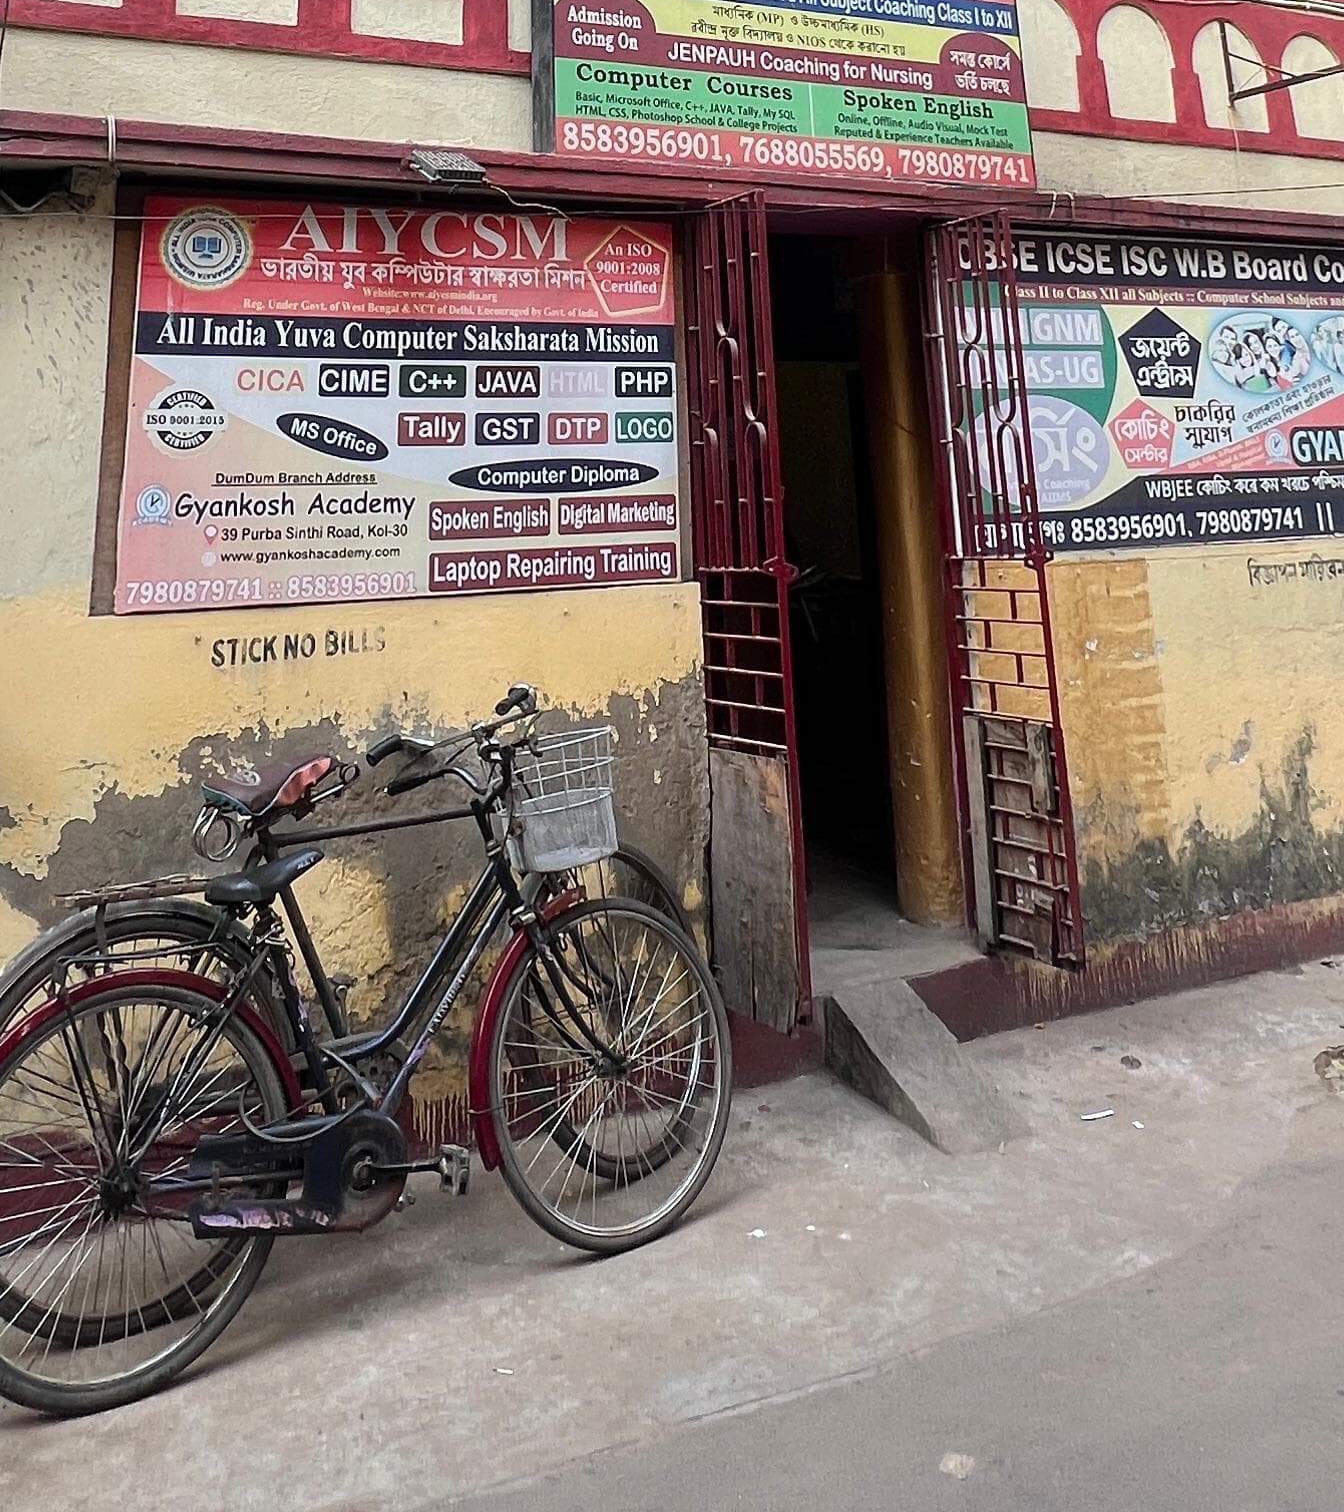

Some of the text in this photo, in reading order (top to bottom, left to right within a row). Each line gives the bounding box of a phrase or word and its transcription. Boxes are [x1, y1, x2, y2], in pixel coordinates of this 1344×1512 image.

[567, 5, 642, 30] Admission
[937, 2, 973, 24] Class
[981, 9, 995, 27] to
[571, 26, 639, 52] Going On
[668, 41, 934, 89] JENPAUH Coaching for Nursing
[576, 62, 794, 101] Computer Courses
[606, 93, 652, 108] Microsoft
[653, 97, 683, 112] Office,
[763, 108, 776, 121] My
[778, 109, 796, 121] SQL
[844, 88, 994, 120] Spoken English
[563, 121, 1029, 184] 8583956901, 7688055569, 7980879741
[278, 204, 573, 263] AIYCSM
[604, 244, 653, 259] An ISO
[1045, 240, 1115, 276] ICSE
[1120, 244, 1167, 277] ISC
[1173, 247, 1227, 280] W.B
[1233, 250, 1307, 283] Board
[260, 252, 336, 283] ভারতীয়
[341, 258, 366, 290] যুব
[371, 257, 465, 287] কম্পিউটার
[543, 263, 588, 290] মিশন
[596, 261, 660, 276] 9001:2008
[601, 279, 657, 295] Certified
[157, 317, 659, 357] All India Yuva Computer Saksharata Mission
[1032, 311, 1102, 343] GNM
[236, 369, 306, 392] CICA
[320, 369, 389, 392] CIME
[409, 370, 458, 393] C++
[478, 370, 538, 393] JAVA
[550, 371, 606, 394] HTML
[620, 370, 669, 393] PHP
[289, 417, 378, 456] MS Office
[402, 416, 462, 444] Tally
[483, 418, 534, 441] GST
[556, 418, 601, 440] DTP
[618, 418, 673, 440] LOGO
[215, 471, 377, 484] DumDum Branch Address
[478, 465, 640, 489] Computer Diploma
[1145, 479, 1193, 499] WBJEE
[175, 490, 416, 525] Gyankosh Academy
[431, 504, 550, 536] Spoken English
[561, 500, 675, 529] Digital Marketing
[220, 524, 408, 541] 39 Purba Sinthi Road, Kol-30
[1071, 505, 1304, 543] 8583956901, 7980879741
[220, 548, 401, 564] www.gyankoshacademy.com
[433, 546, 673, 588] Laptop Repairing Training
[126, 572, 416, 605] 7980879741 8583956901
[211, 634, 278, 668] STICK
[284, 632, 316, 660] NO
